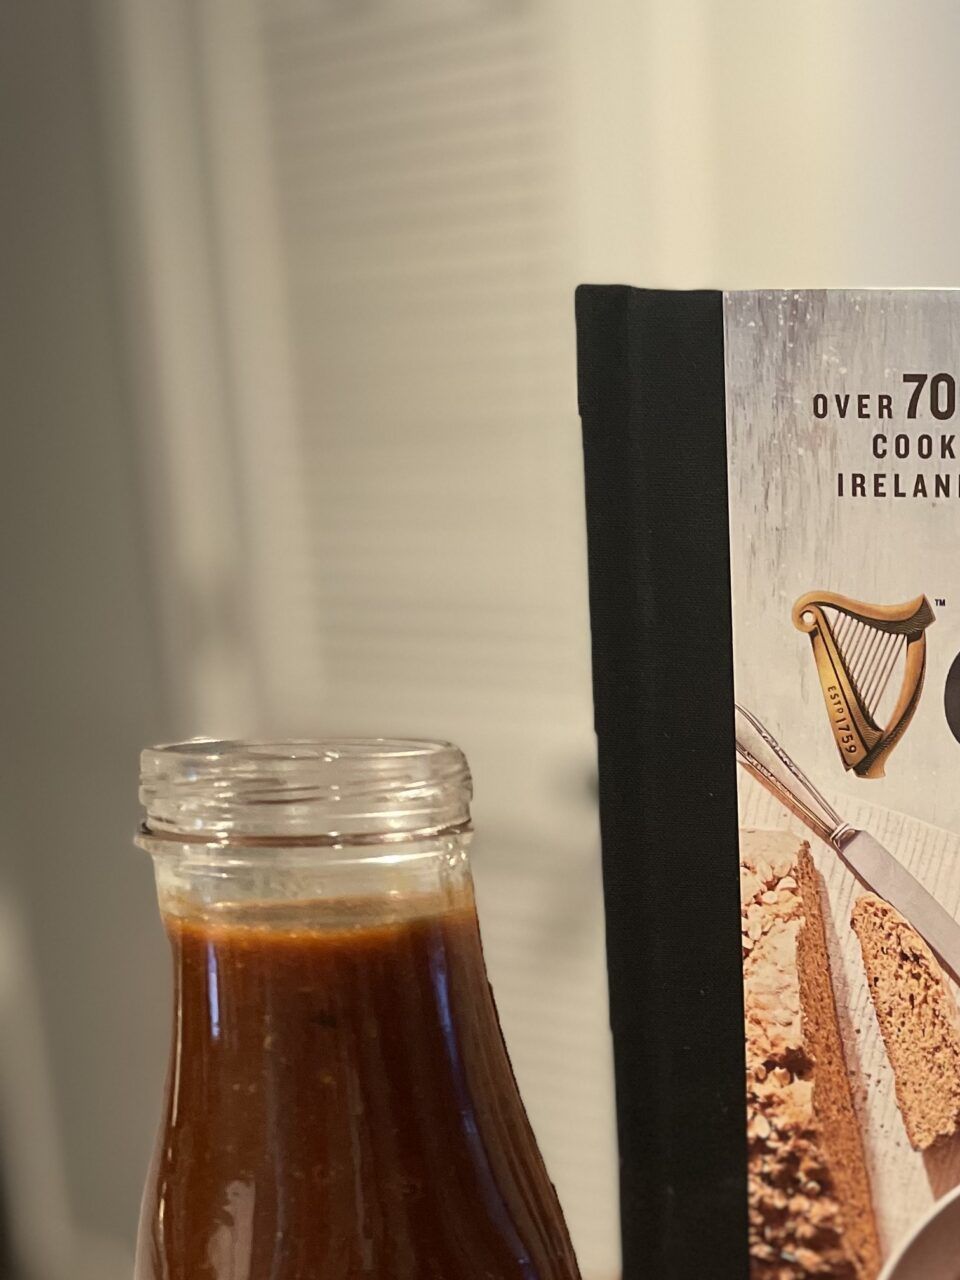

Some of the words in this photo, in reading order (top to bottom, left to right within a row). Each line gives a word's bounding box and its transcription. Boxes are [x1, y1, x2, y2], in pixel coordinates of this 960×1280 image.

[812, 393, 893, 420] OVER
[902, 372, 956, 421] 70
[835, 716, 857, 754] 1759
